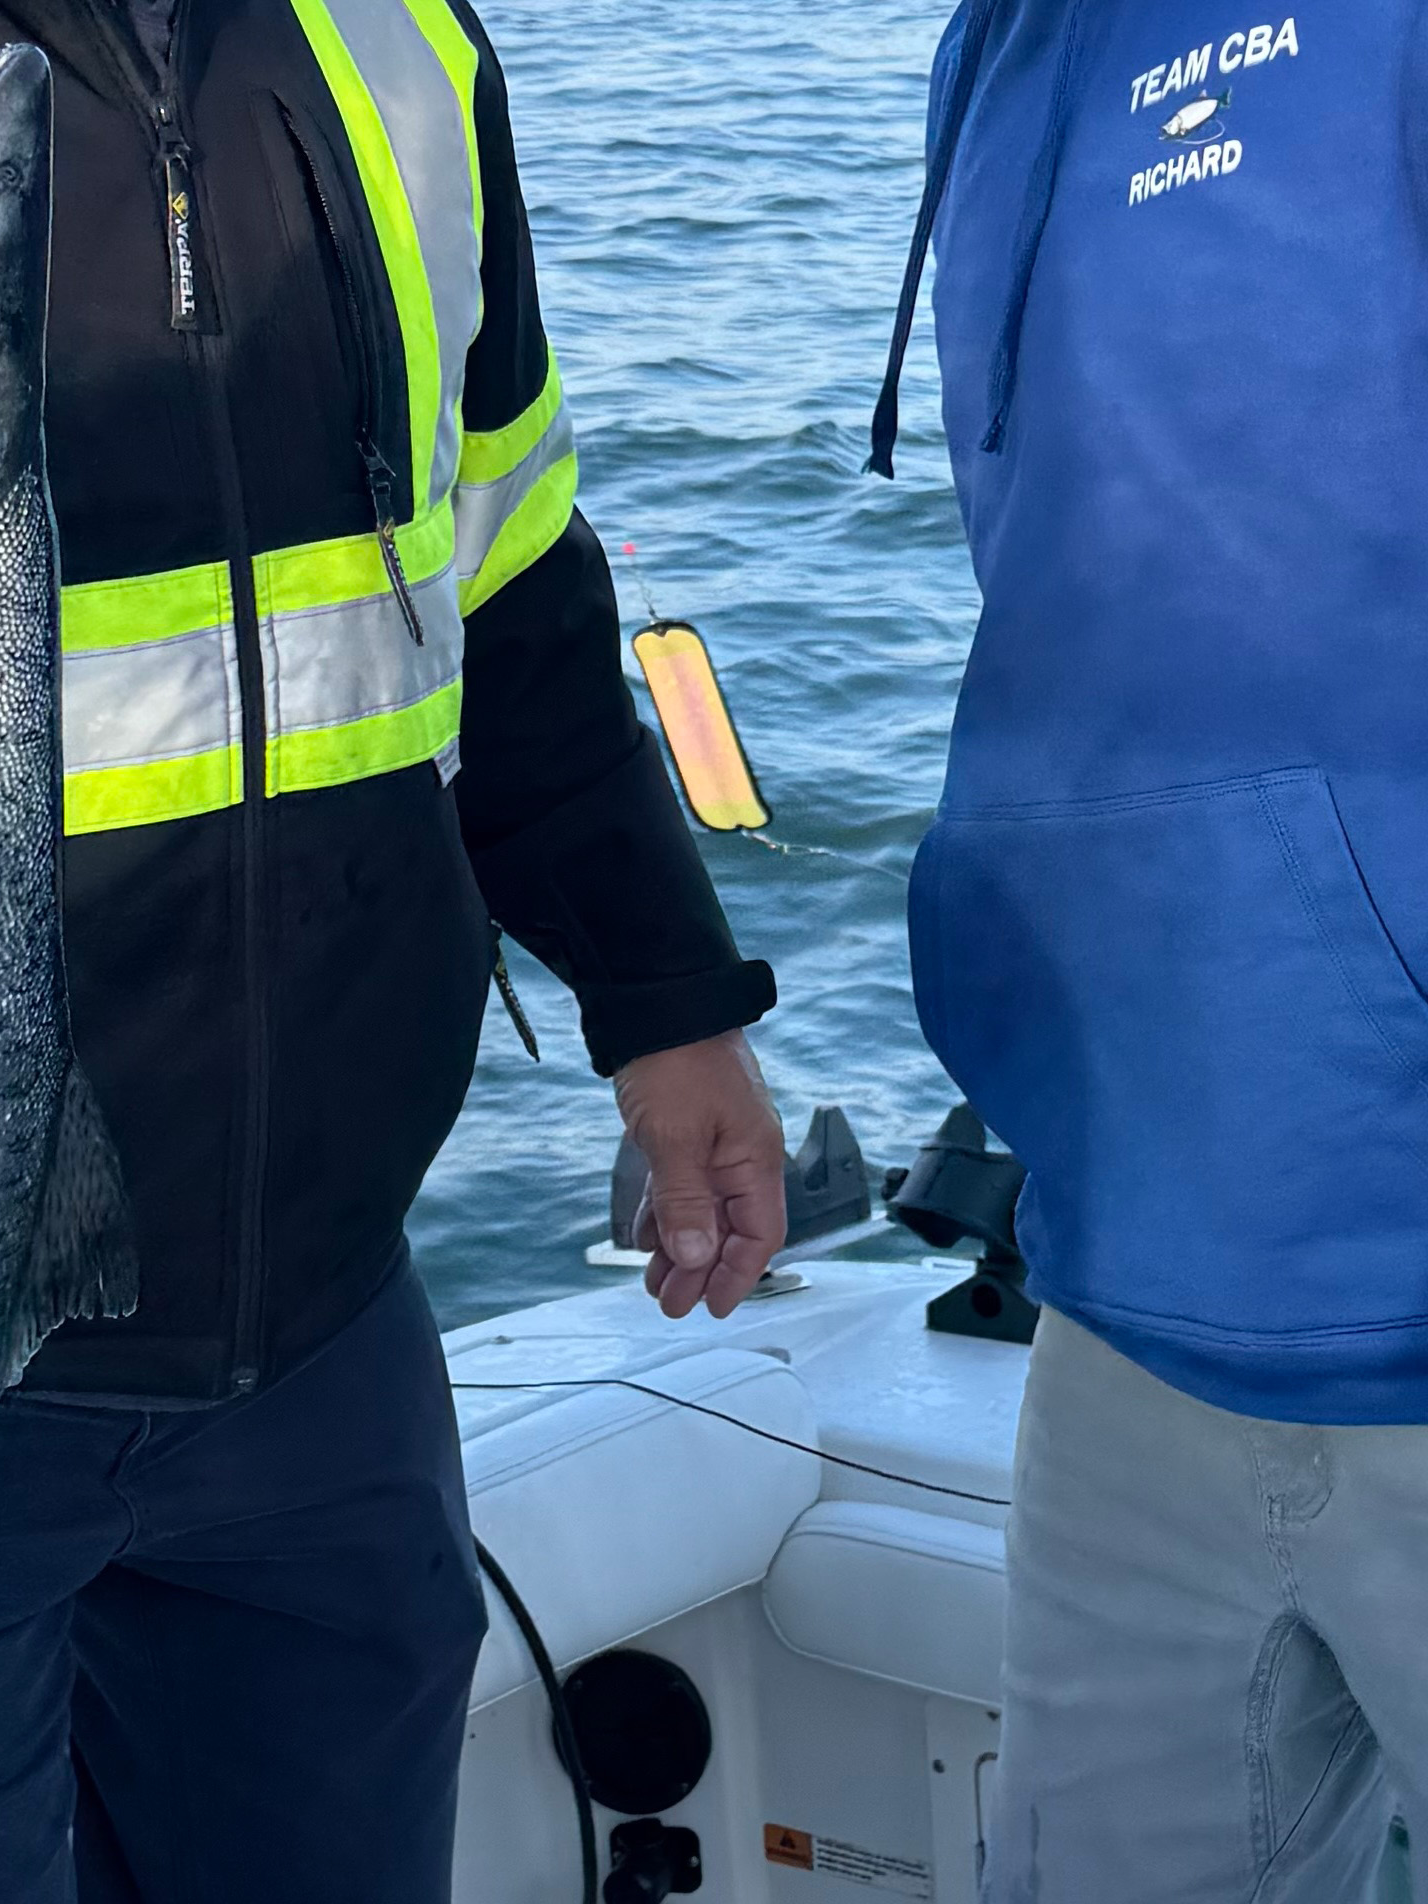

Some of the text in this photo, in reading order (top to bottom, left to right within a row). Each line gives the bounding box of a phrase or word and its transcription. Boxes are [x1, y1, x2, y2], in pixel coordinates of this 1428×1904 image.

[1130, 17, 1299, 114] TEAM CBA
[1128, 139, 1243, 207] RICHARD
